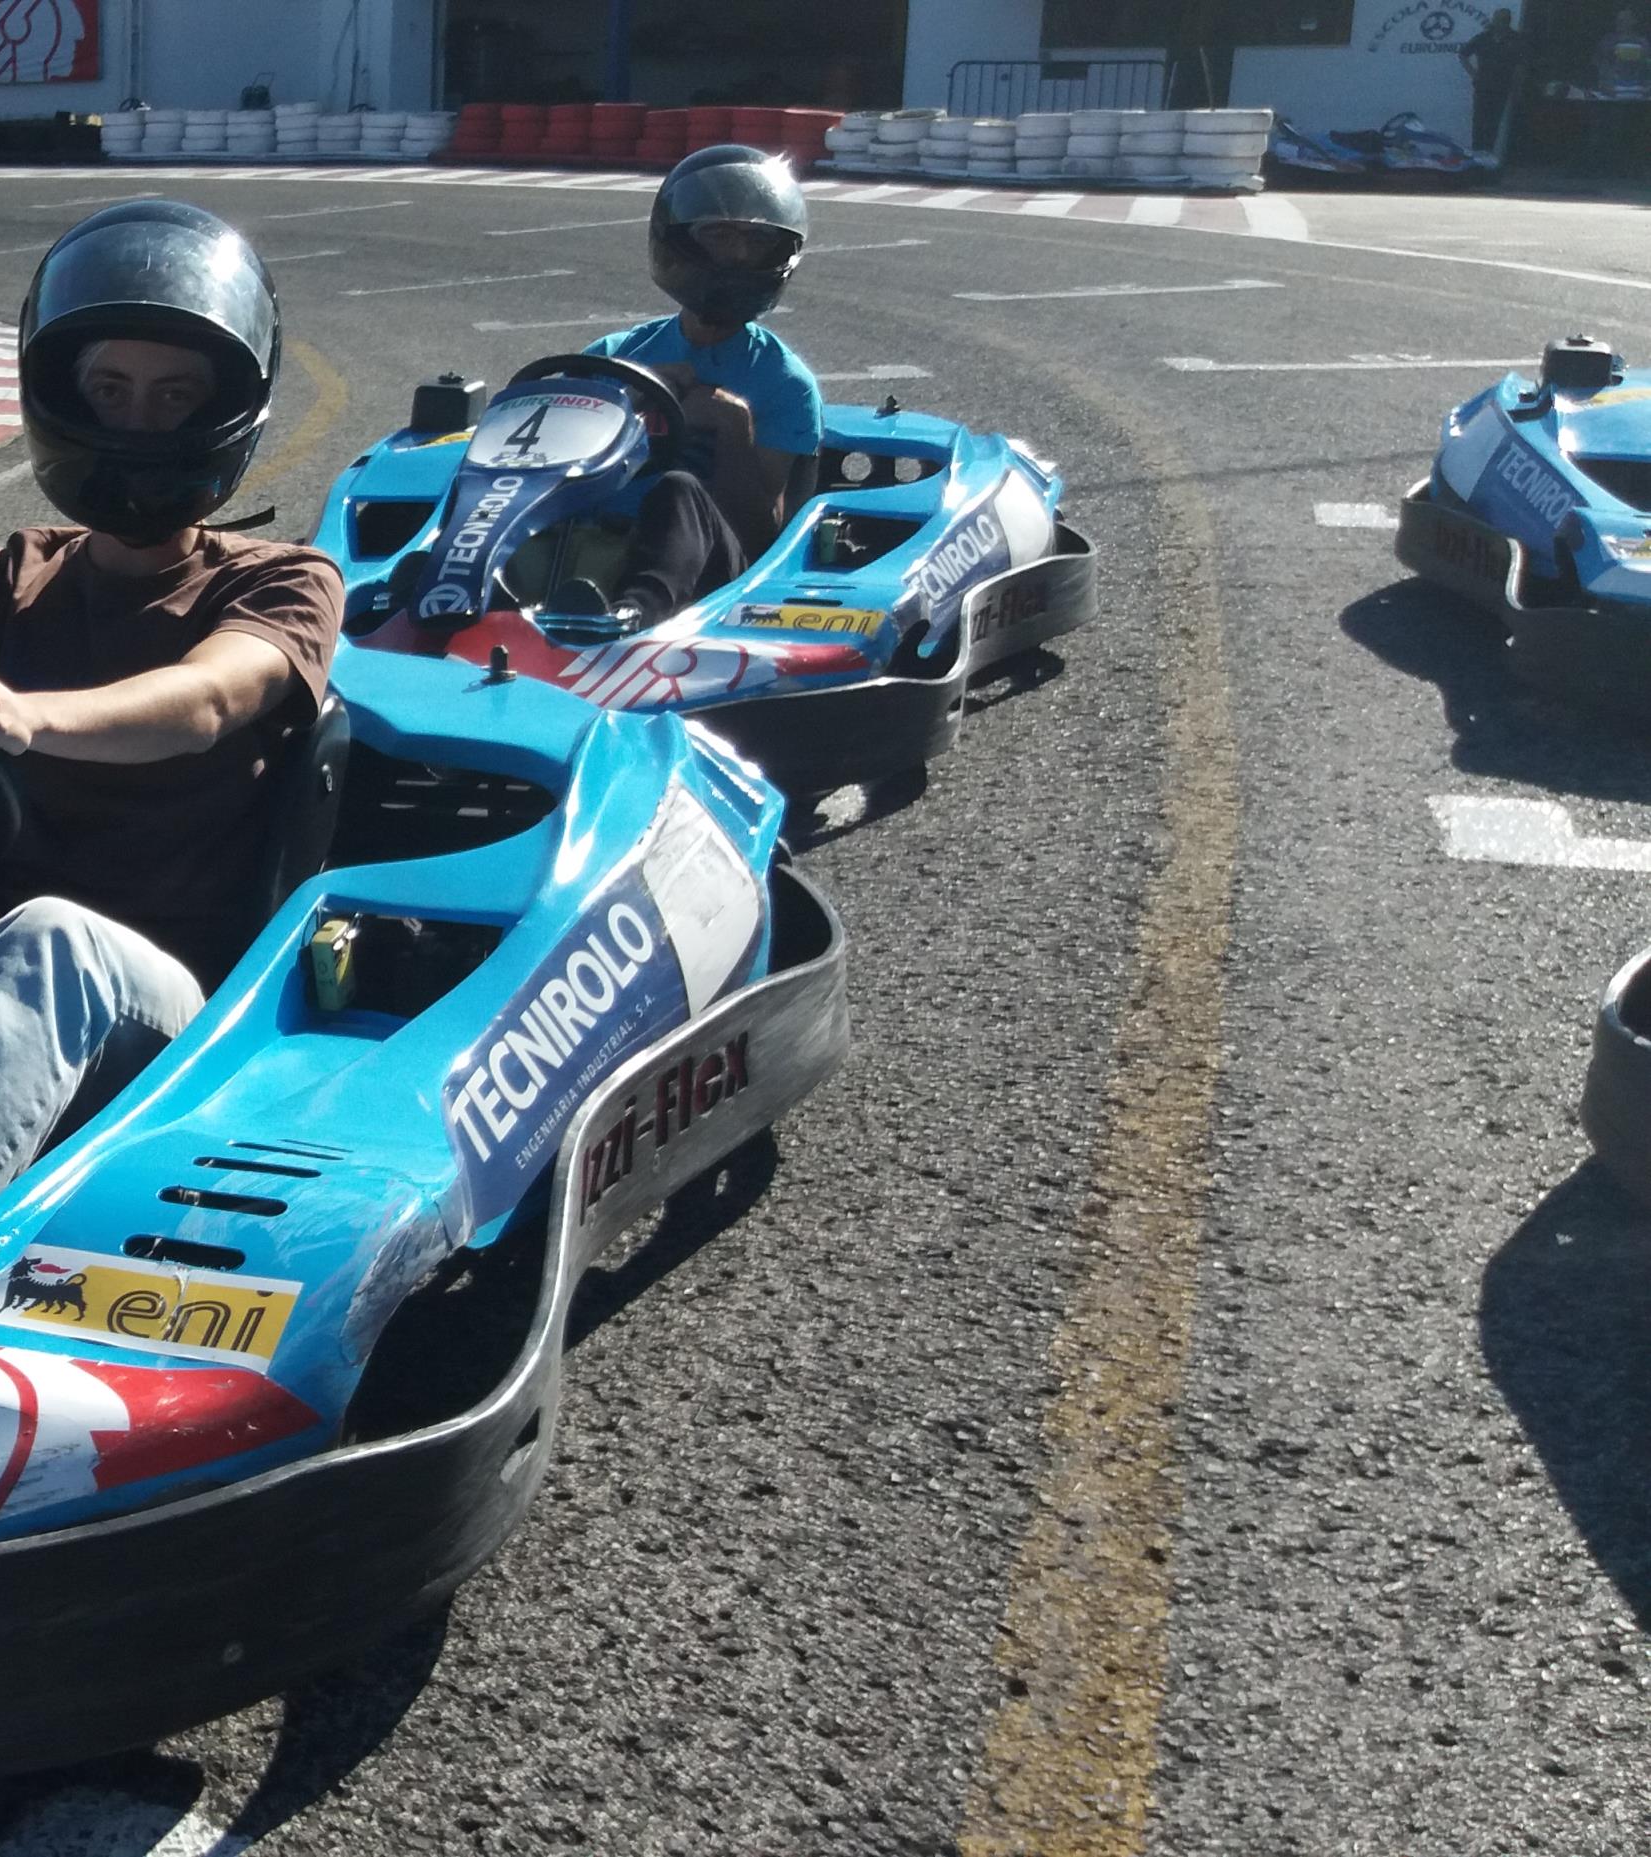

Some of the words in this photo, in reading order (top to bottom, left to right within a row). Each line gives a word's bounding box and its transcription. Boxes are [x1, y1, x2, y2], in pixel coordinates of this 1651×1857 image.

[499, 396, 605, 412] EUROINDY
[503, 404, 551, 457] 4
[792, 609, 874, 635] eni
[450, 901, 654, 1163] TECNIROLO
[514, 1089, 579, 1171] ENGENHARIA
[106, 1289, 275, 1353] eni
